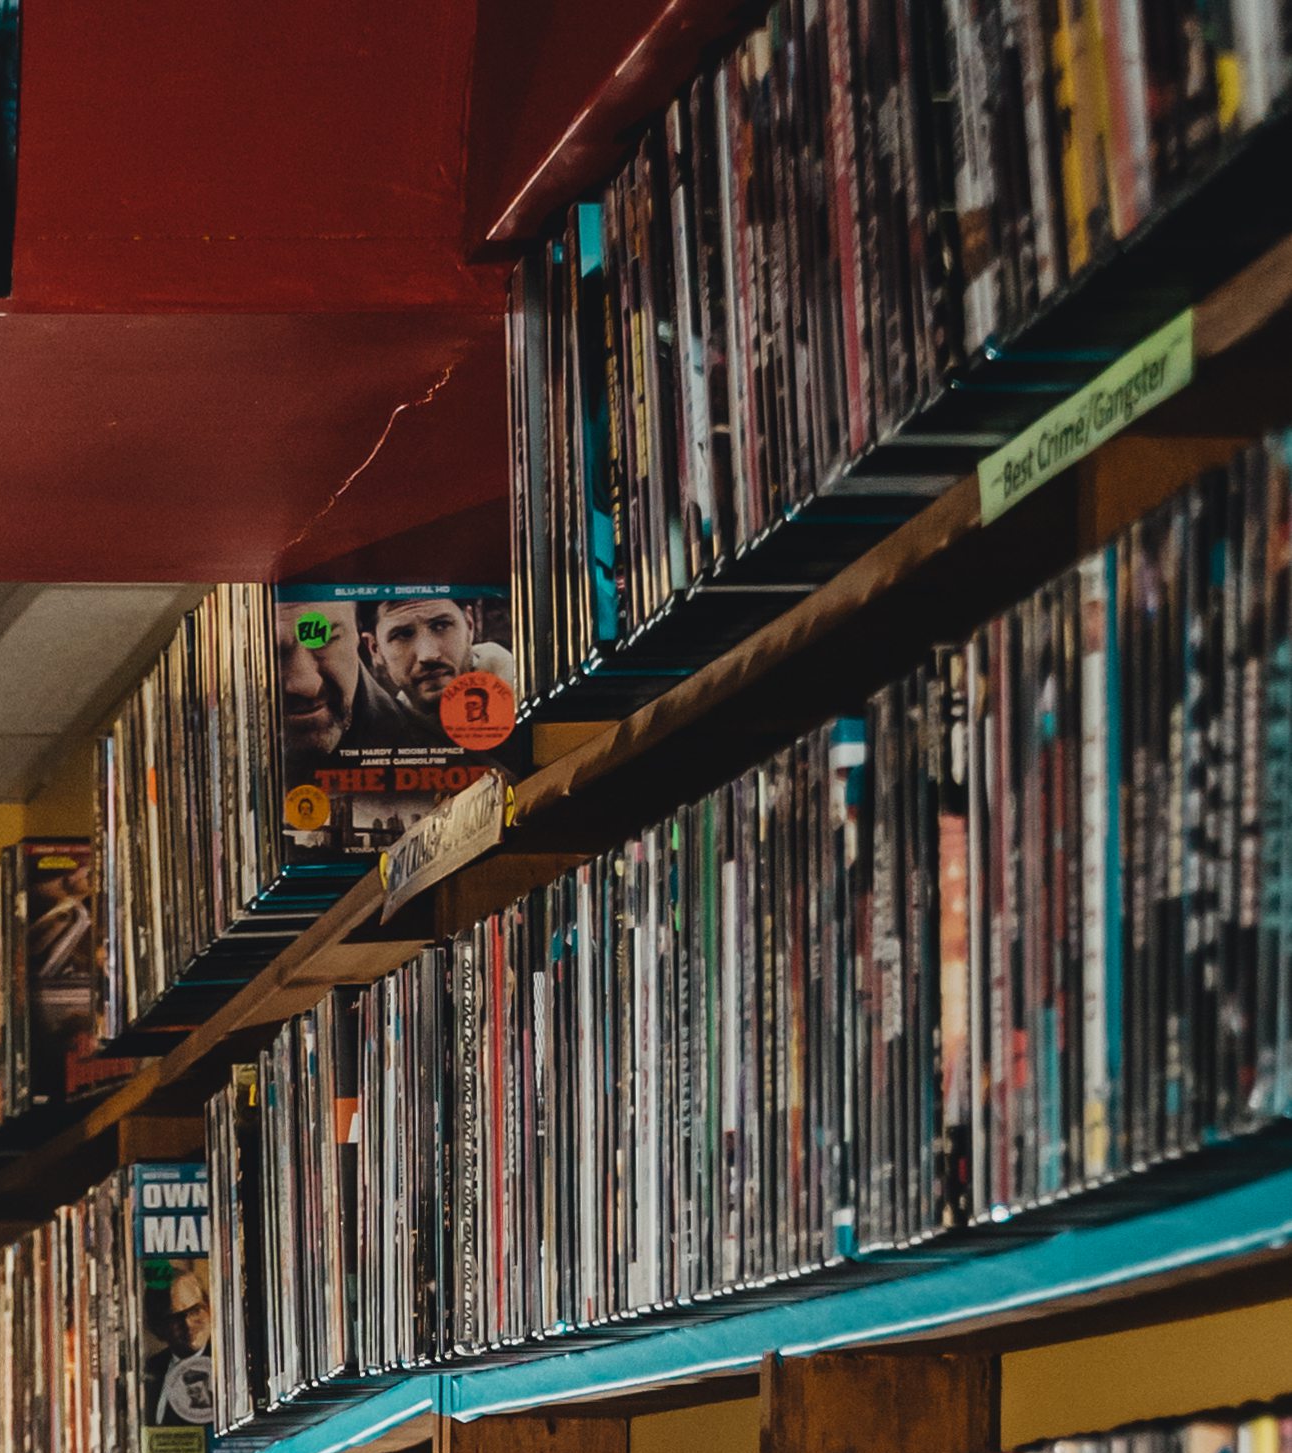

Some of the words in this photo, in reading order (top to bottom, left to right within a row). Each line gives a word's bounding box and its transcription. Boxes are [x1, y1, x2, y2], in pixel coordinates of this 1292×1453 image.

[1003, 450, 1034, 499] Best
[334, 587, 378, 597] BLU-RAY
[394, 586, 433, 595] DIGITAL
[434, 585, 451, 594] HD
[339, 749, 359, 757] TOM
[362, 748, 392, 757] HARDY
[398, 748, 429, 756] NOOMI
[430, 747, 465, 756] RAPACE
[360, 758, 391, 766] JAMES
[393, 756, 446, 765] GANDOLFINI
[314, 767, 385, 793] THE
